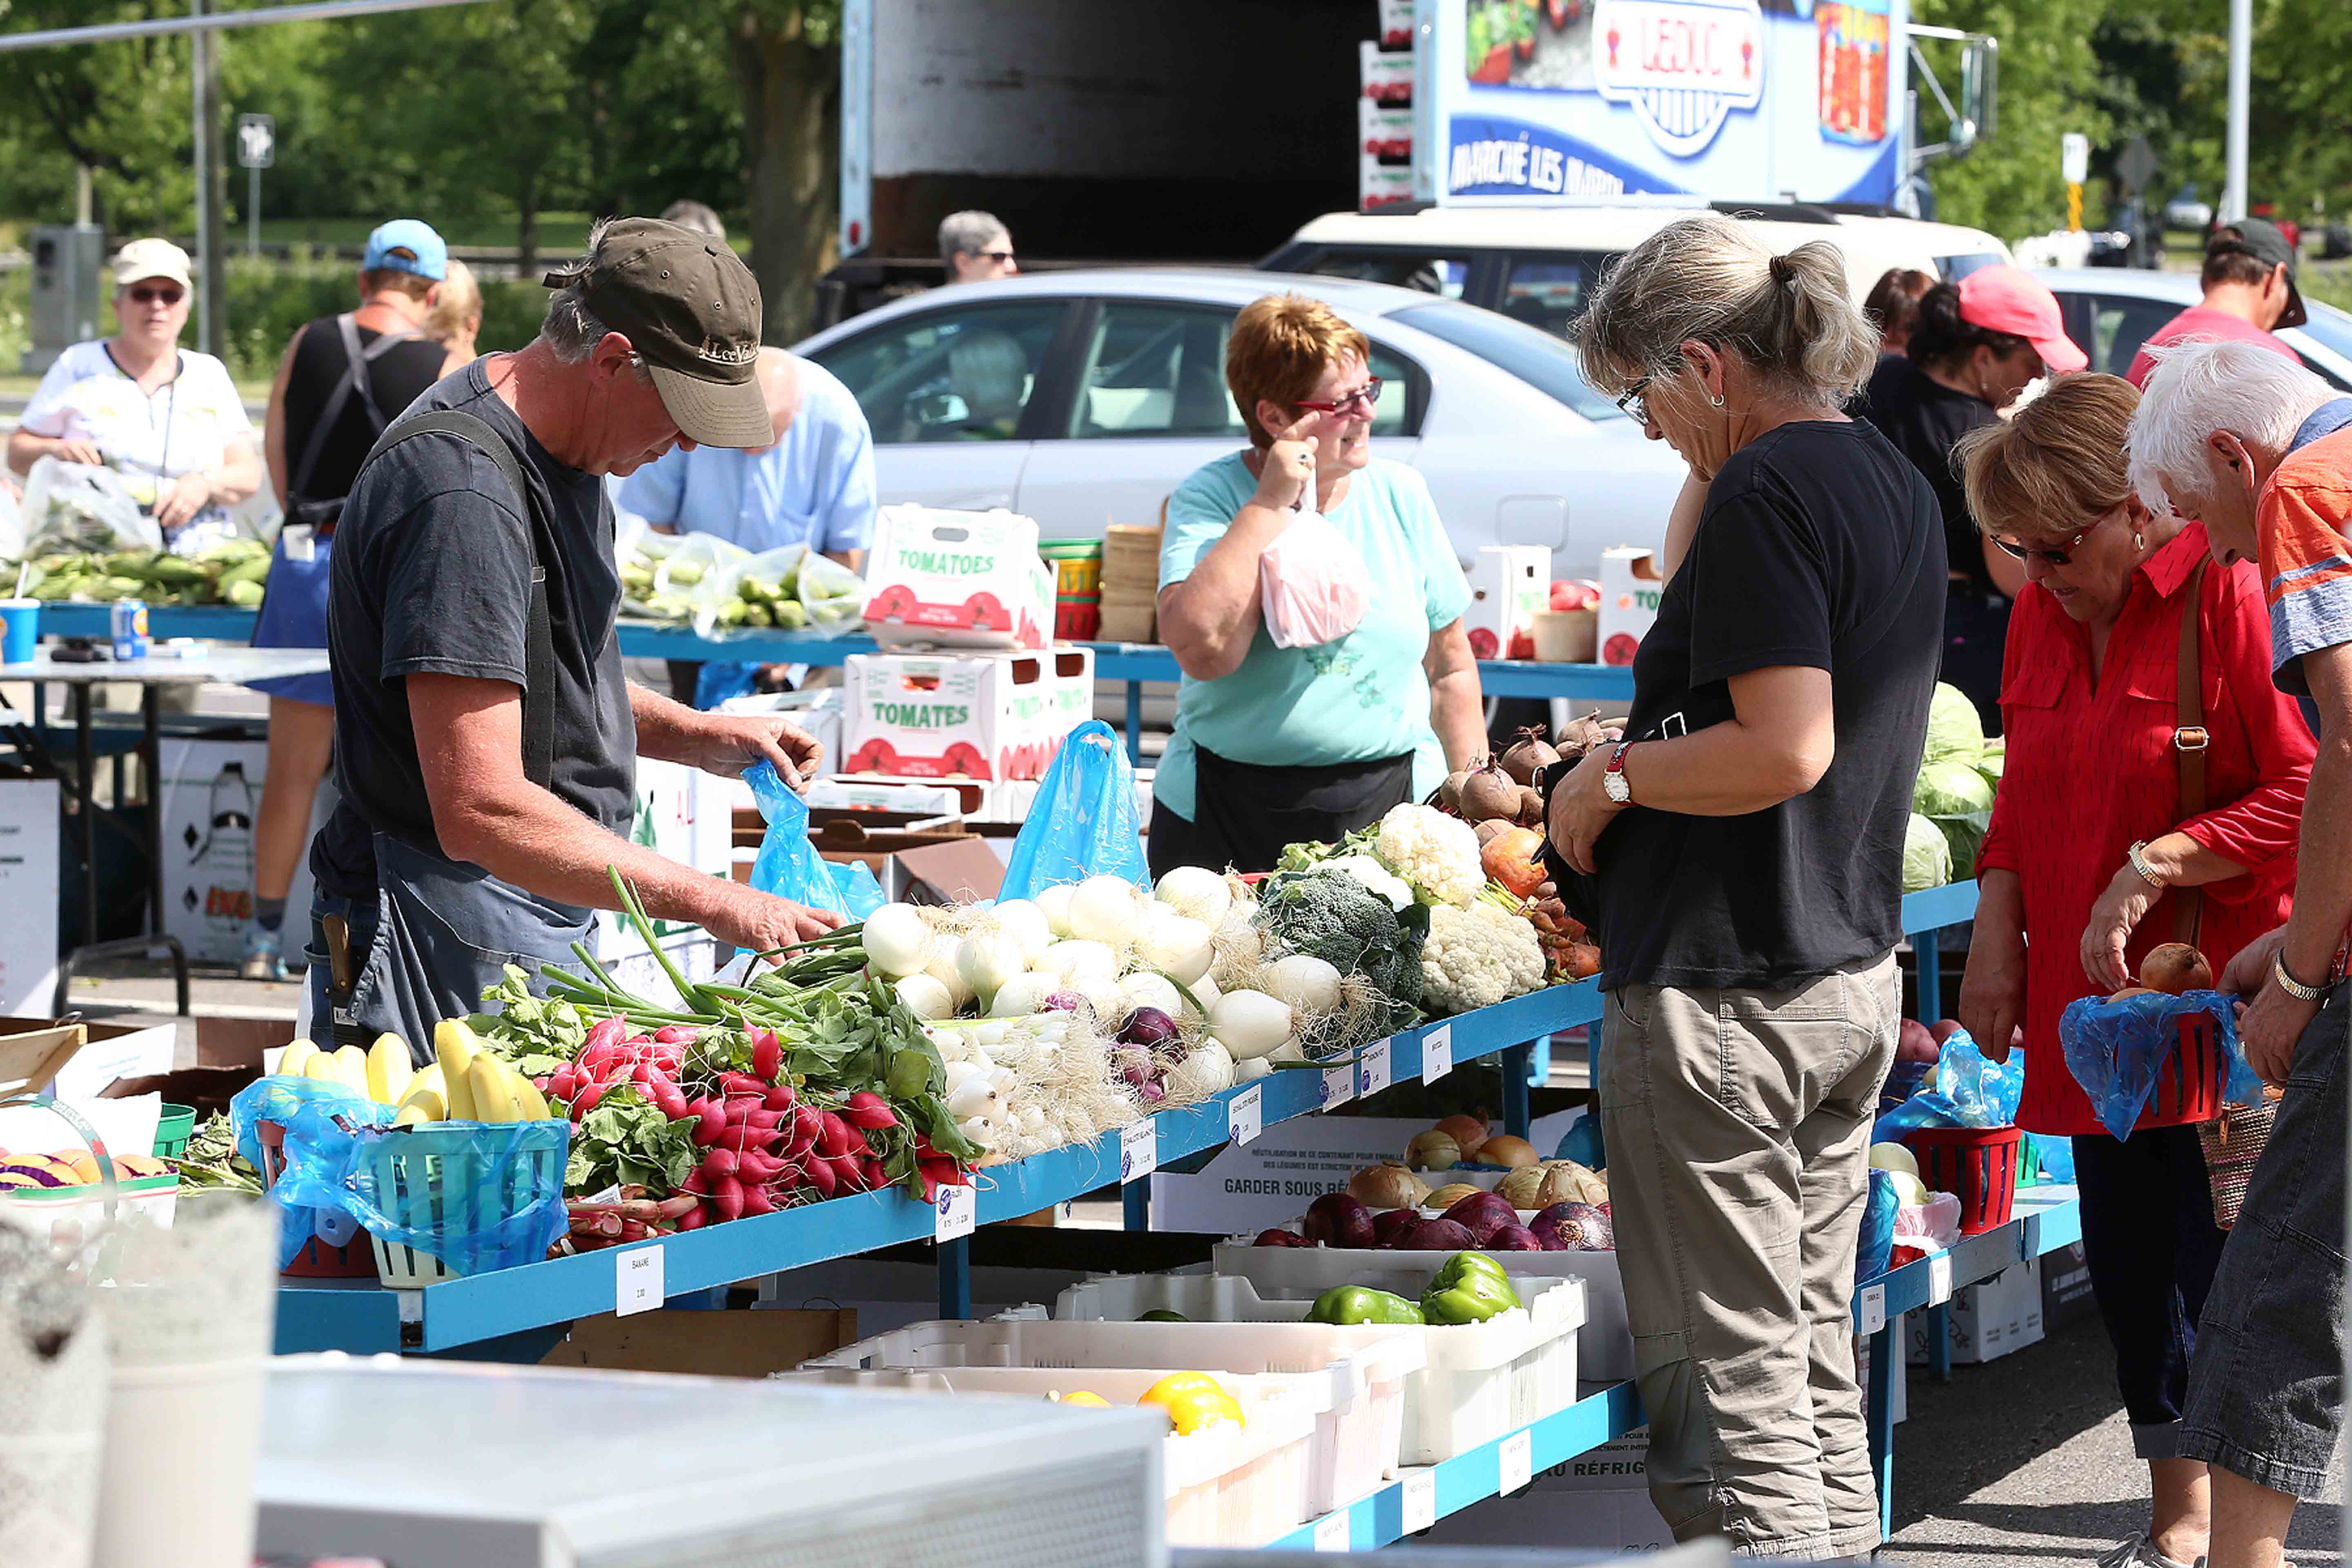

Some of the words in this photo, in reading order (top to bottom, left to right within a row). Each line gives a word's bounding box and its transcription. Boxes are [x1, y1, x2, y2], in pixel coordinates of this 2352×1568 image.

[1641, 18, 1724, 76] LEDUC
[1450, 131, 1529, 190] MARCHÉ
[1529, 145, 1564, 193] LES
[899, 550, 994, 575] TOMATOES
[873, 702, 969, 728] TOMATES
[1252, 1148, 1297, 1158] RÉUTILISATION
[1299, 1149, 1307, 1158] DE
[1319, 1151, 1354, 1159] CONTENANT
[1356, 1152, 1374, 1160] POUR
[1277, 1160, 1305, 1169] LÉGUMES
[1225, 1178, 1280, 1194] GARDER
[1285, 1181, 1322, 1196] SOUS
[1327, 1179, 1349, 1194] RÉ
[1574, 1460, 1645, 1477] RÉFRIG
